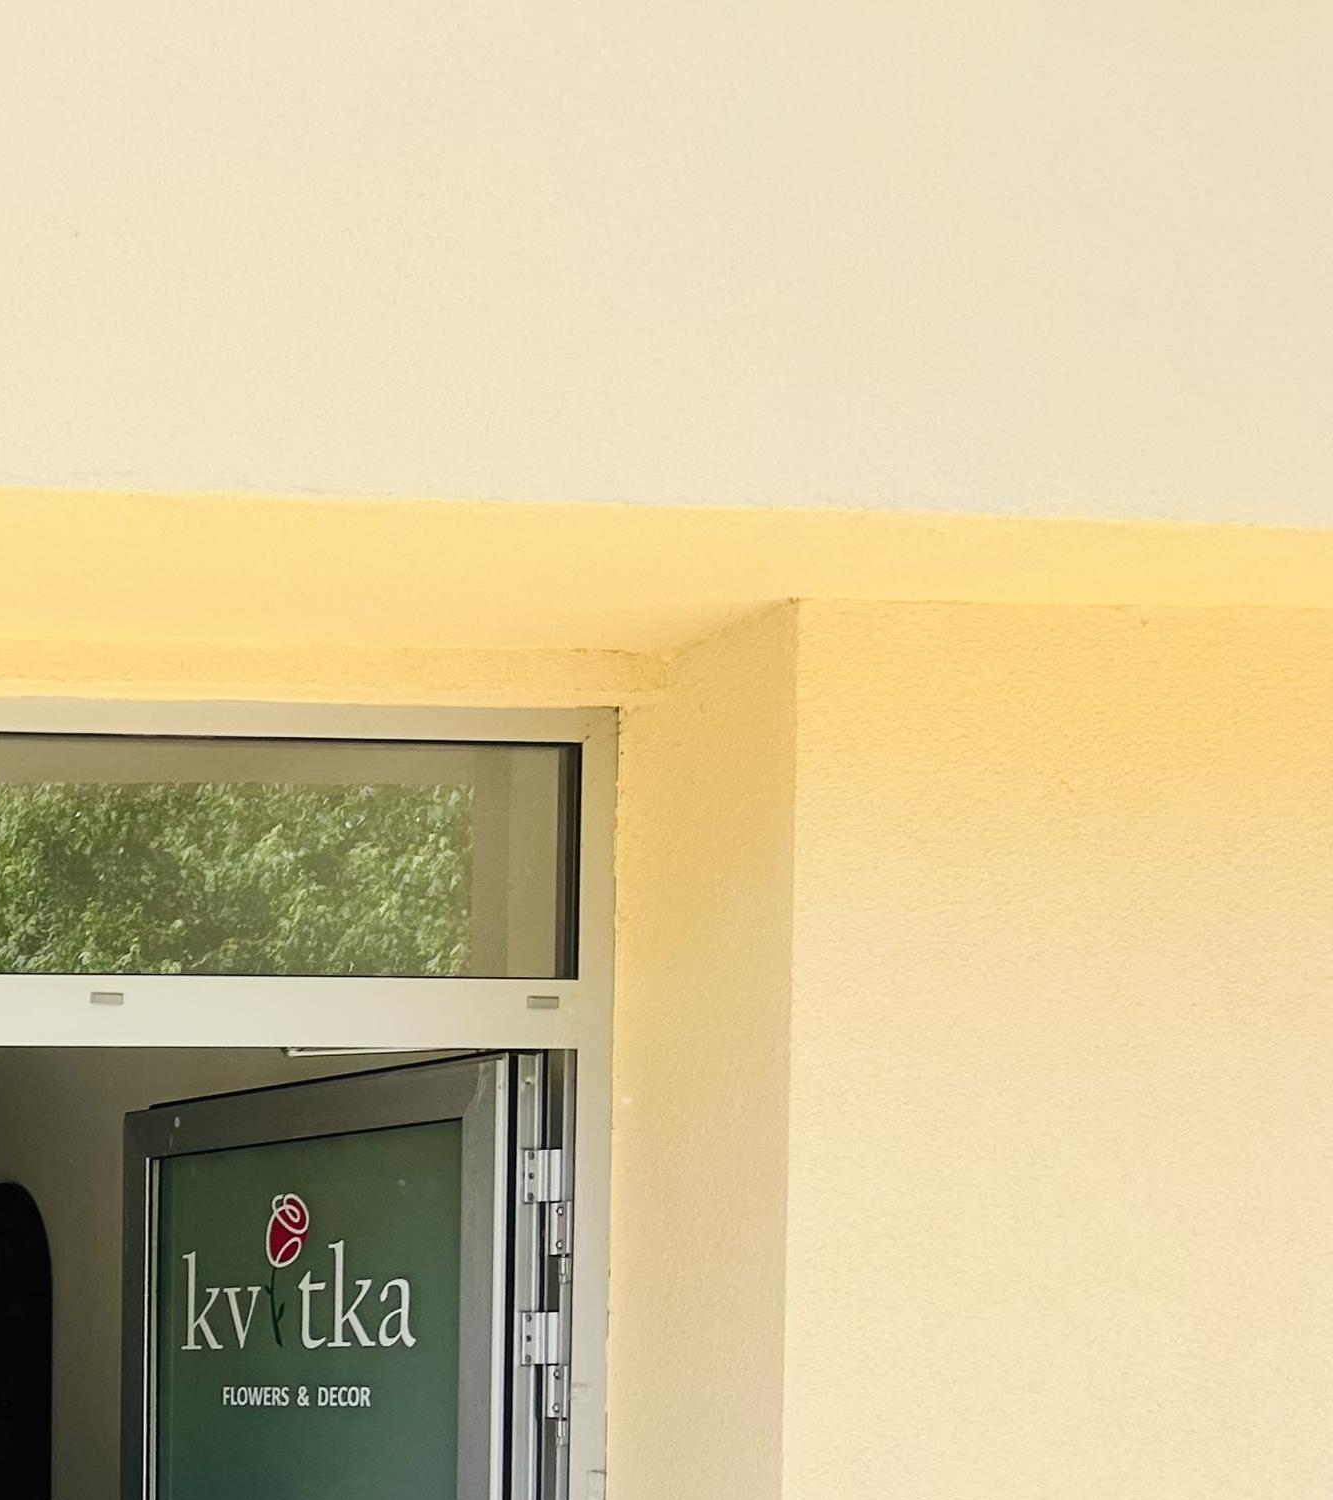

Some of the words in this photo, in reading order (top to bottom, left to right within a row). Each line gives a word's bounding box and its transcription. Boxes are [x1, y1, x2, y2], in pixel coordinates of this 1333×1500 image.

[222, 1386, 289, 1406] FLOWERS
[296, 1386, 310, 1406] &
[317, 1386, 371, 1407] DECOR
